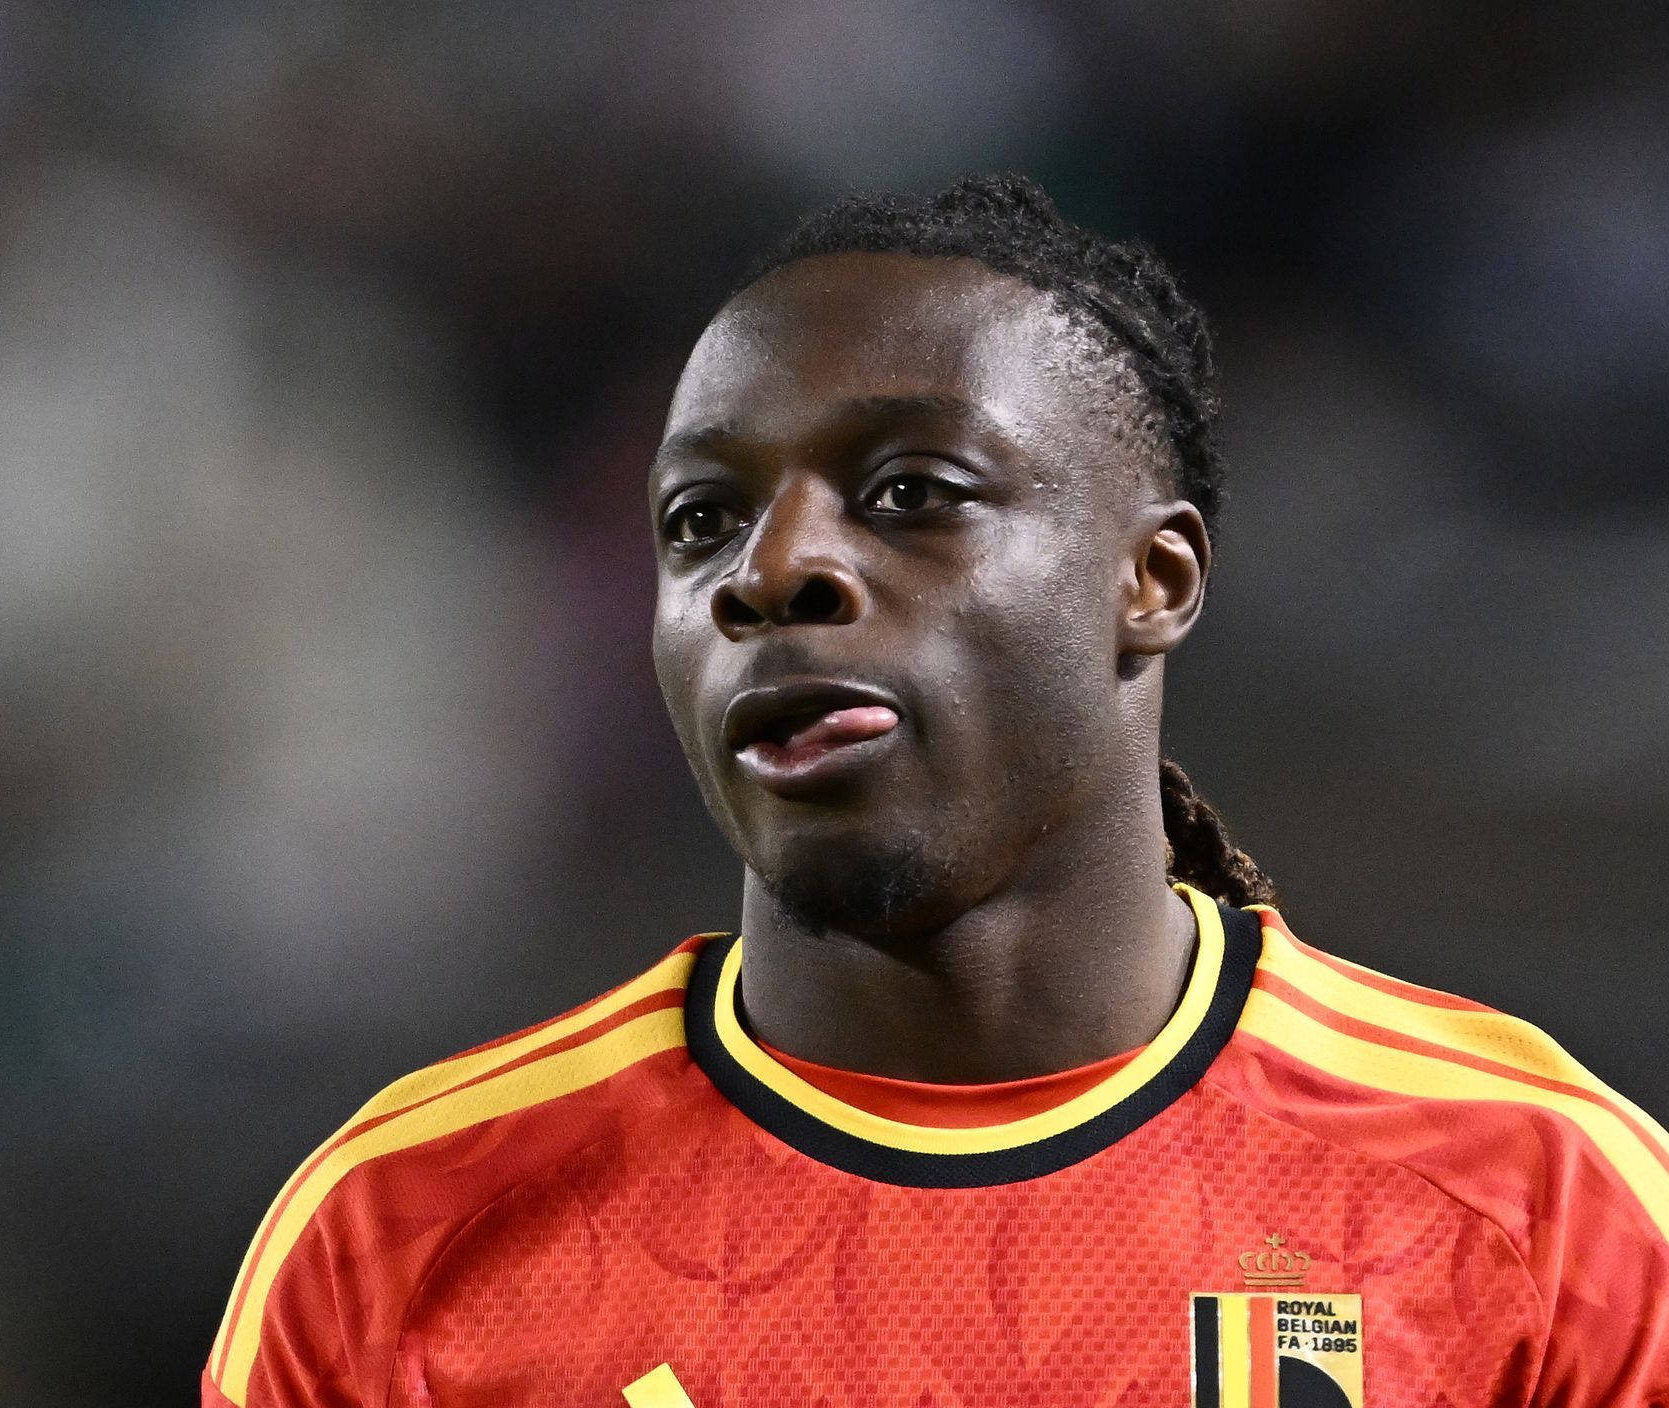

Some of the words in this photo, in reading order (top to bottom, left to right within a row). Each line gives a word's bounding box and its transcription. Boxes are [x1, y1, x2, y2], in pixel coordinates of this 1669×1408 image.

[1277, 1300, 1336, 1316] ROYAL
[1277, 1318, 1357, 1334] BELGIAN
[1277, 1335, 1300, 1349] FA
